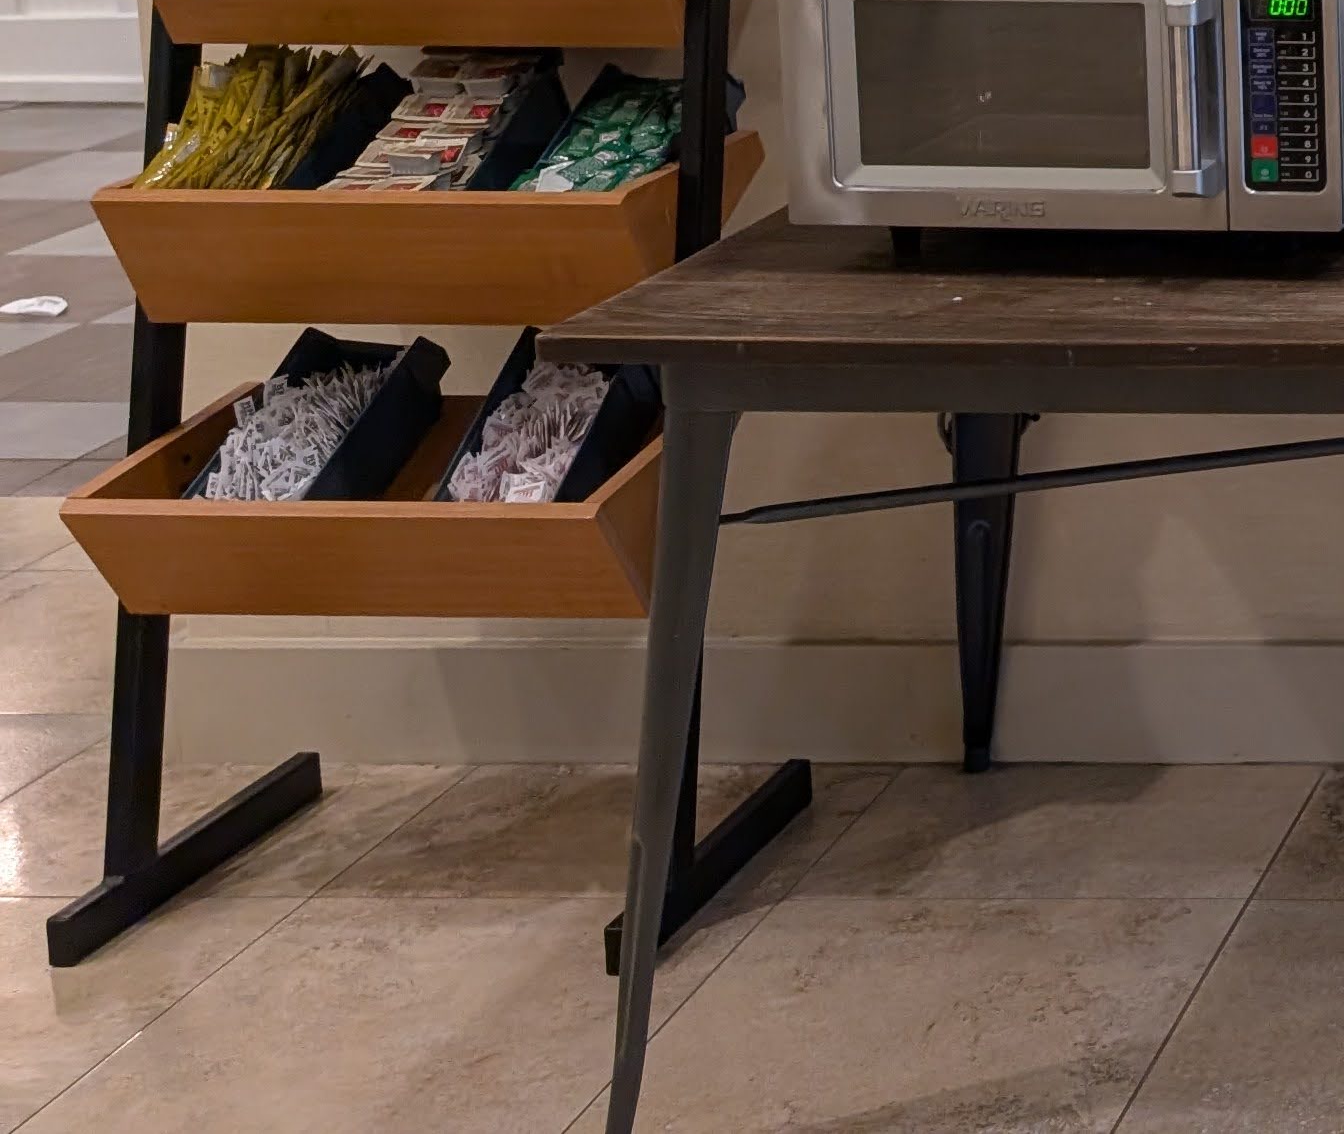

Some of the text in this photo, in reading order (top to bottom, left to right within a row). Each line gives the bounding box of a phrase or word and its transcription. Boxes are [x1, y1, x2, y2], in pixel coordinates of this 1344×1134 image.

[1302, 33, 1307, 41] 1
[1301, 48, 1308, 57] 2
[1302, 64, 1309, 72] 3
[1303, 94, 1310, 102] 5
[1303, 109, 1310, 118] 6
[1304, 140, 1311, 148] 8
[1305, 155, 1311, 163] 9
